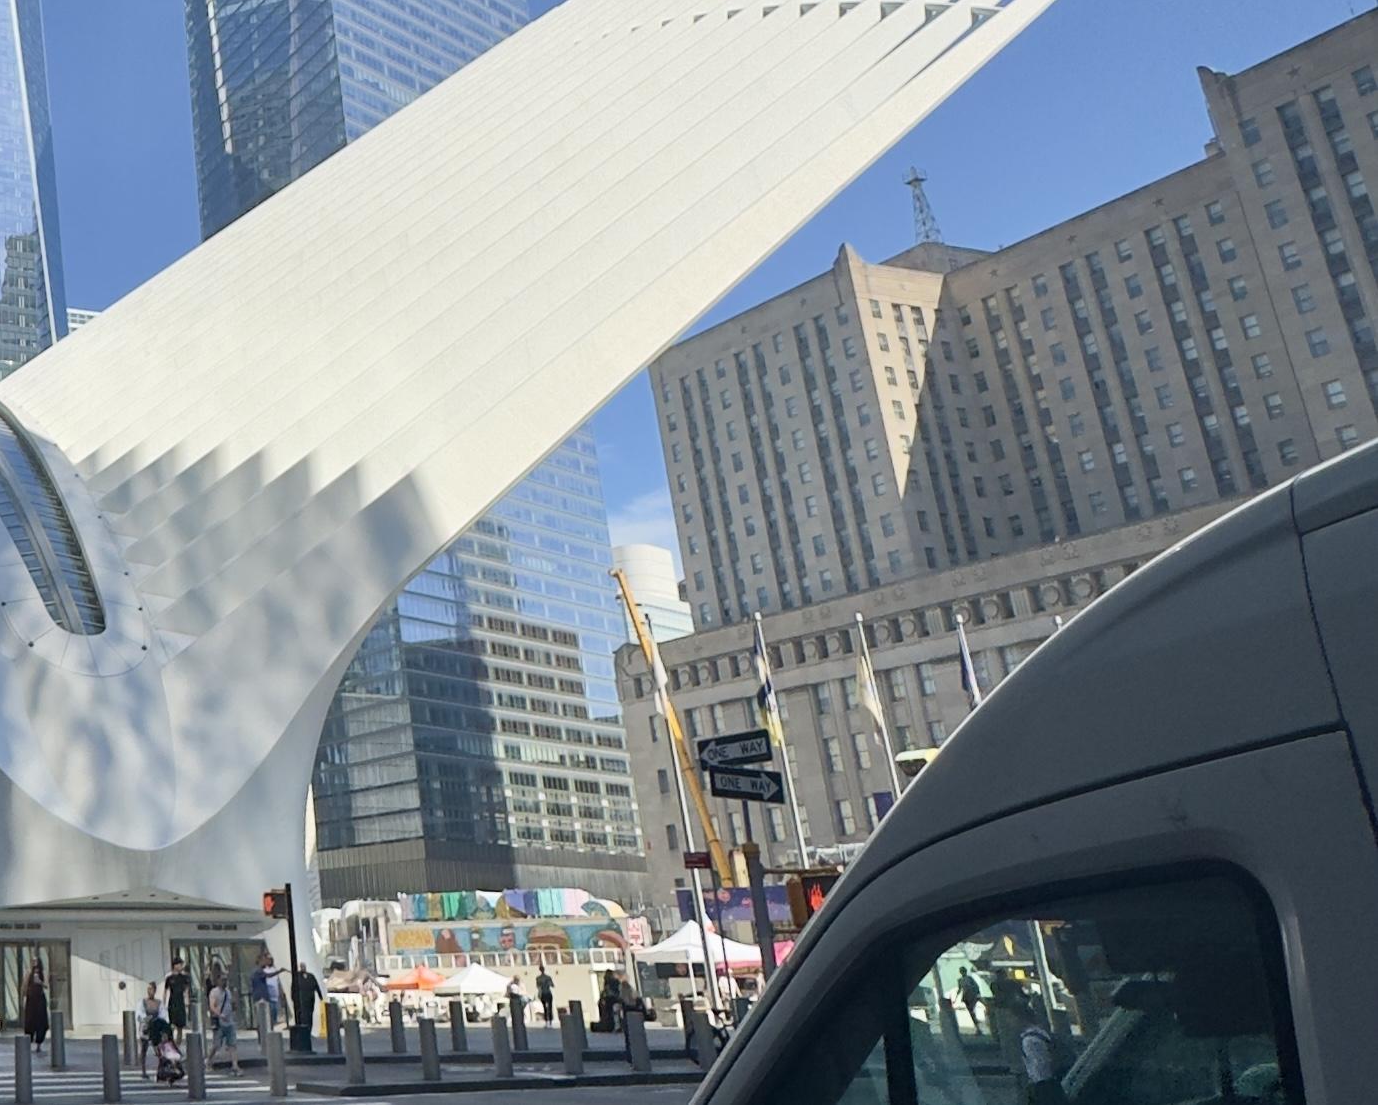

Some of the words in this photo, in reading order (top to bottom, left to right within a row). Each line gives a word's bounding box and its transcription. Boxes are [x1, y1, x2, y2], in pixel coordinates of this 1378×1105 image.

[707, 745, 729, 760] ONE
[739, 740, 763, 754] WAY
[720, 776, 742, 789] ONE
[750, 779, 771, 793] WAY
